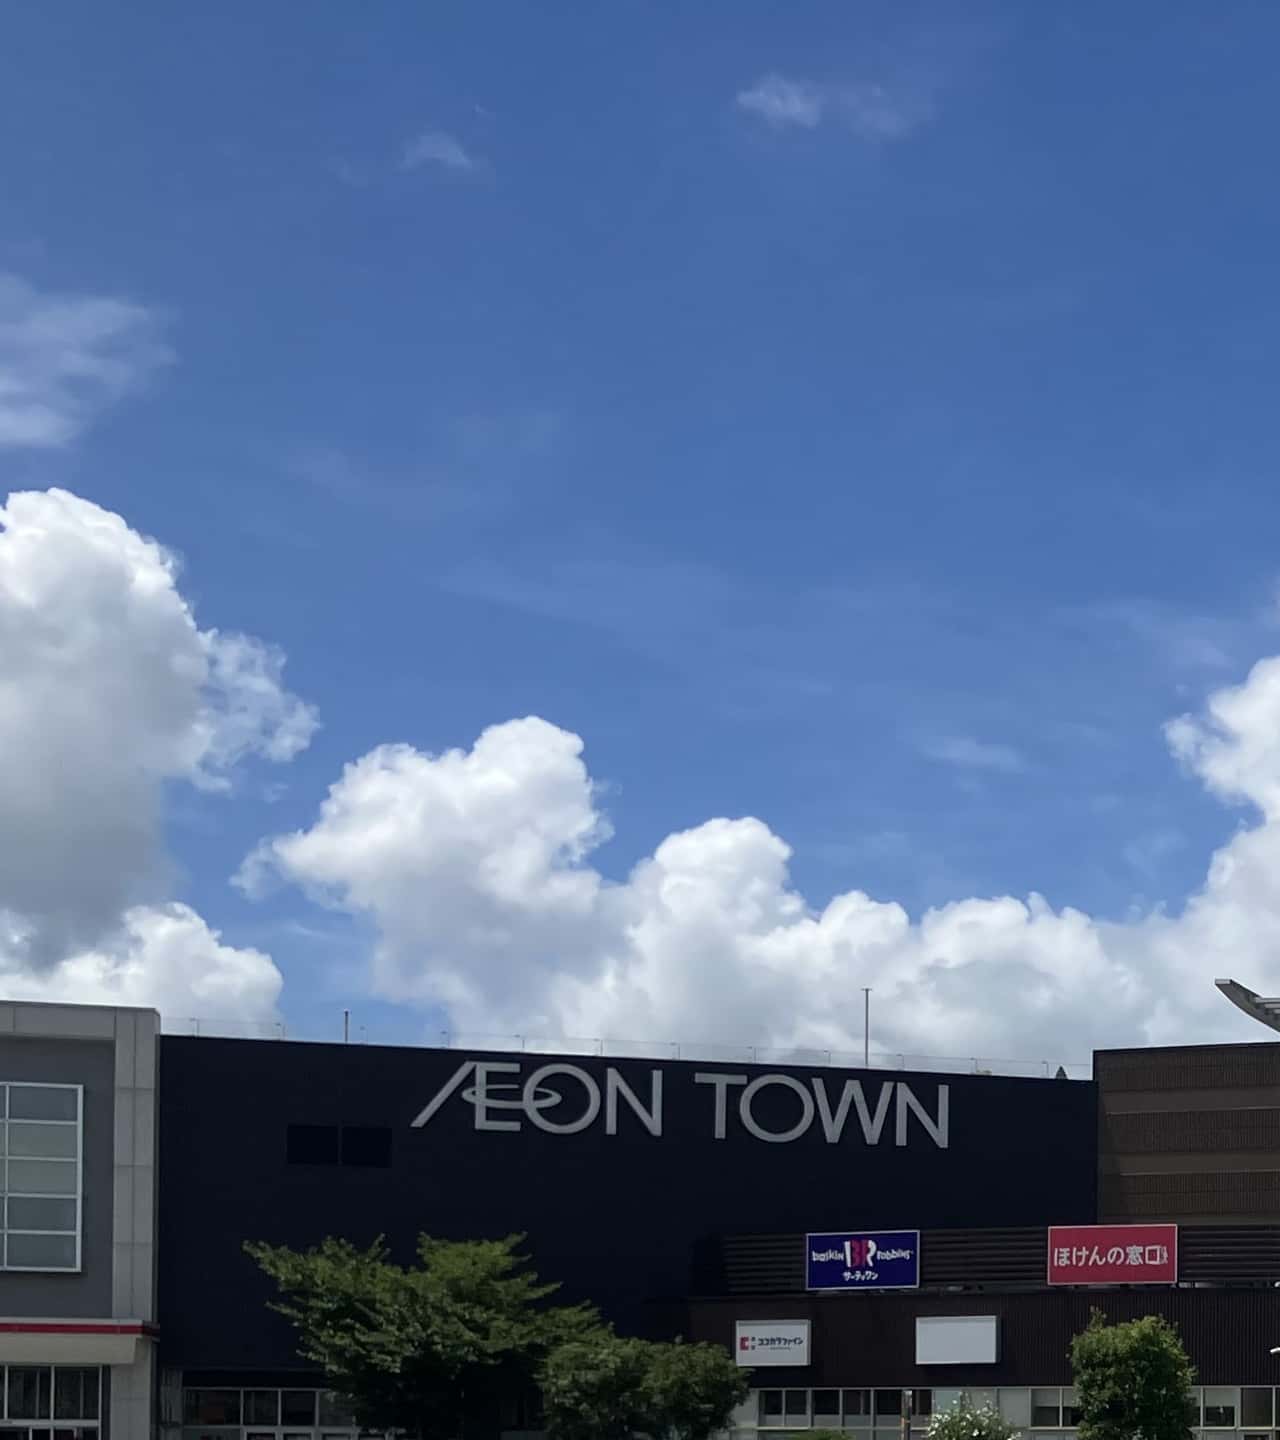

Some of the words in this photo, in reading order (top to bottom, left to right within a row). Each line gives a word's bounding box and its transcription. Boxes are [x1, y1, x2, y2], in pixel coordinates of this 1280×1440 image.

[694, 1072, 950, 1149] TOWN
[1053, 1245, 1161, 1267] ほけんの窓口
